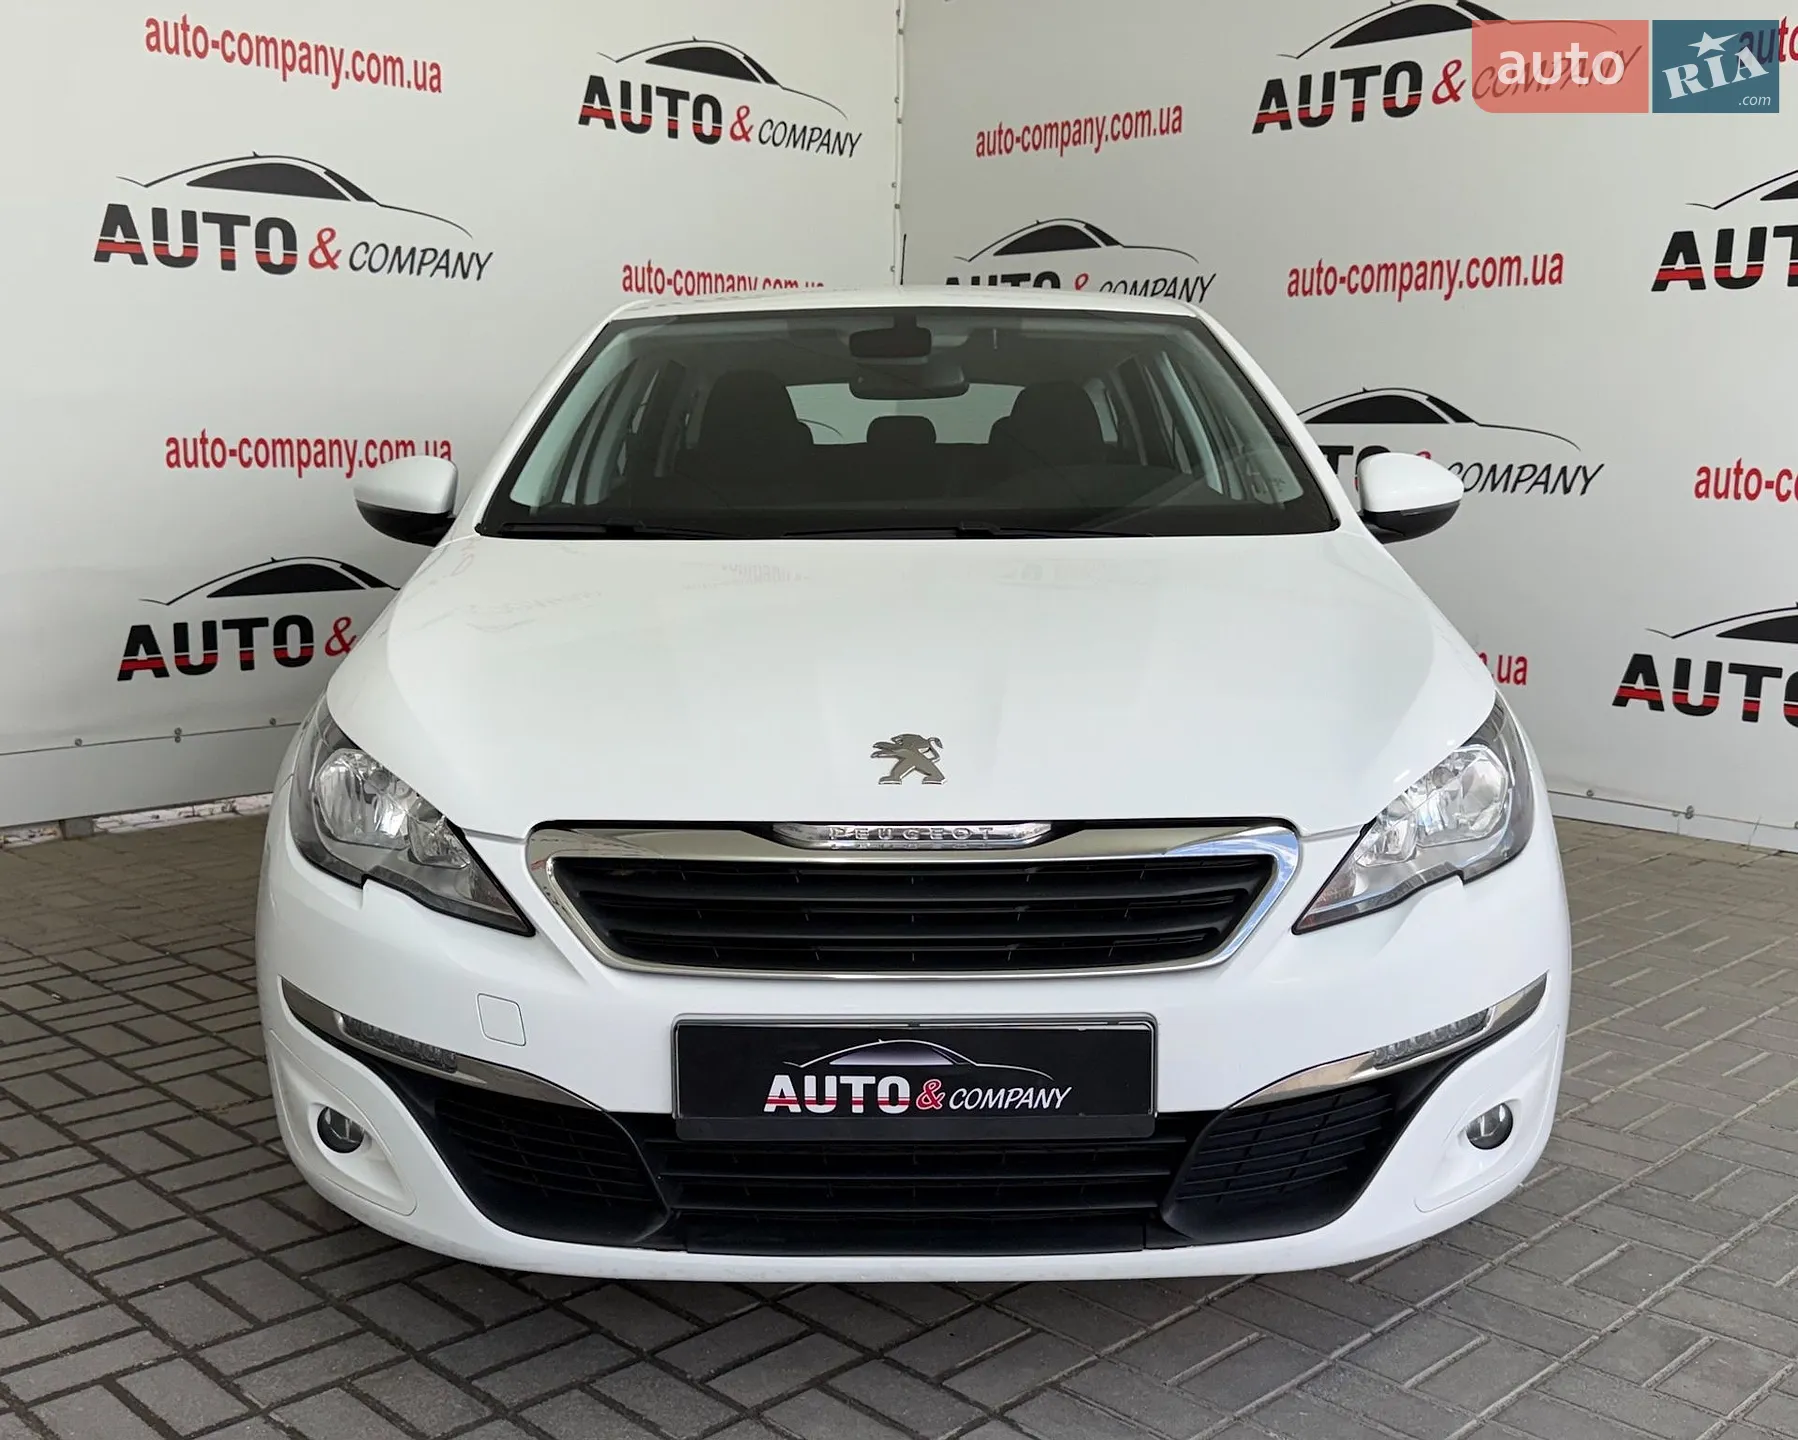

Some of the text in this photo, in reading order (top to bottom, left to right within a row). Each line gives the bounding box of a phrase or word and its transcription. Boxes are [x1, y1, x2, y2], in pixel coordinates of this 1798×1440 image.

[145, 15, 442, 95] auto-company.com.ua
[578, 75, 862, 159] AUTO & COMPANY
[975, 105, 1183, 158] auto-company.com.ua
[1252, 60, 1423, 135] AUTO
[1431, 60, 1467, 106] &
[93, 203, 493, 282] AUTO & COMPANY
[1287, 252, 1565, 303] auto-company.com.ua
[117, 613, 315, 682] AUTO
[828, 826, 995, 841] PEUGEOT
[763, 1074, 1073, 1114] AUTO & COMPANY
